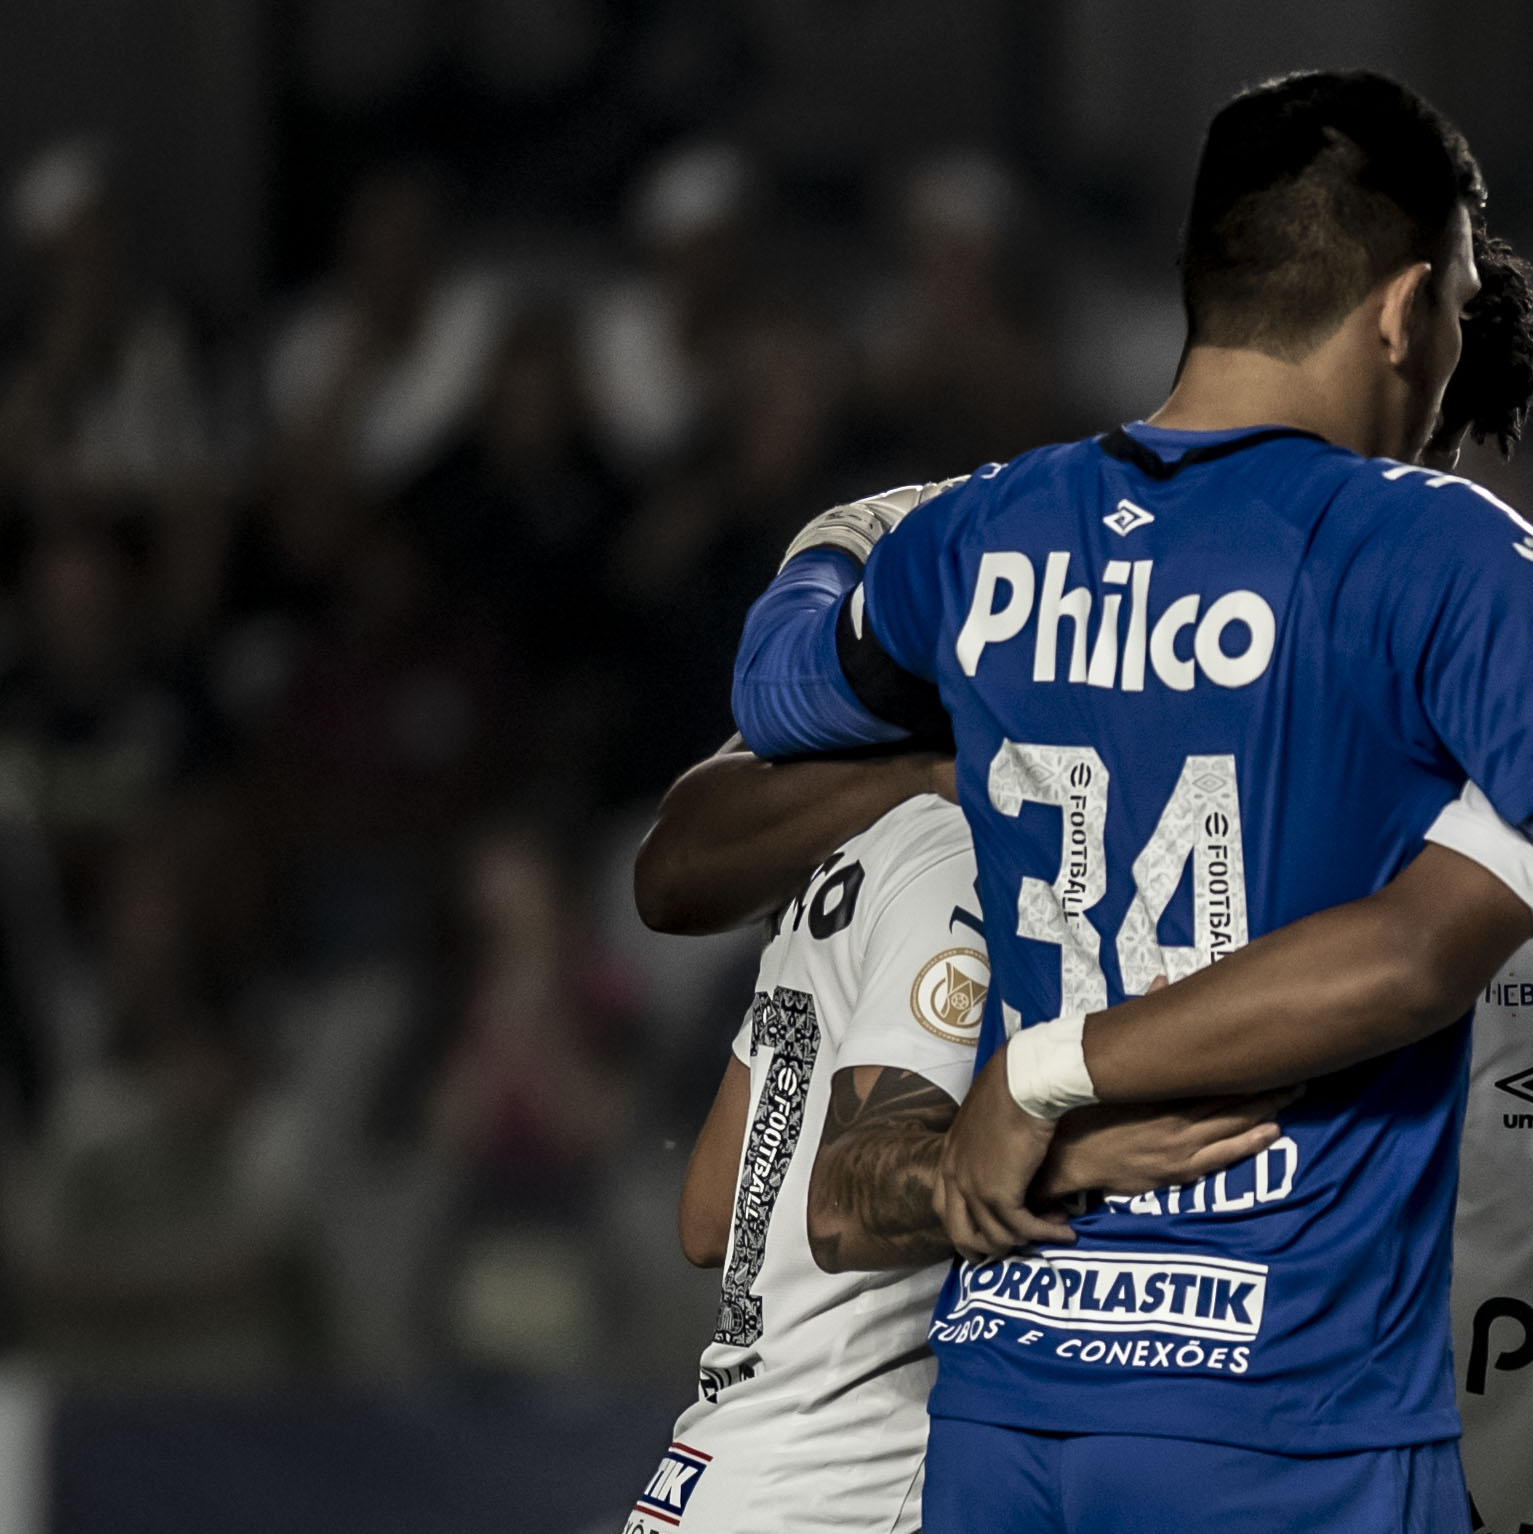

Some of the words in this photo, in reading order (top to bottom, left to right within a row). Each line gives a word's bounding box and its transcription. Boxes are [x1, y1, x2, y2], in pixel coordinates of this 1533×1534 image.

[957, 552, 1276, 691] Philco
[987, 737, 1250, 1040] 34
[1207, 845, 1233, 964] FOOTBAL
[928, 1315, 1005, 1344] TUBOS
[1017, 1329, 1045, 1346] E
[1056, 1340, 1251, 1375] CONEXÕES
